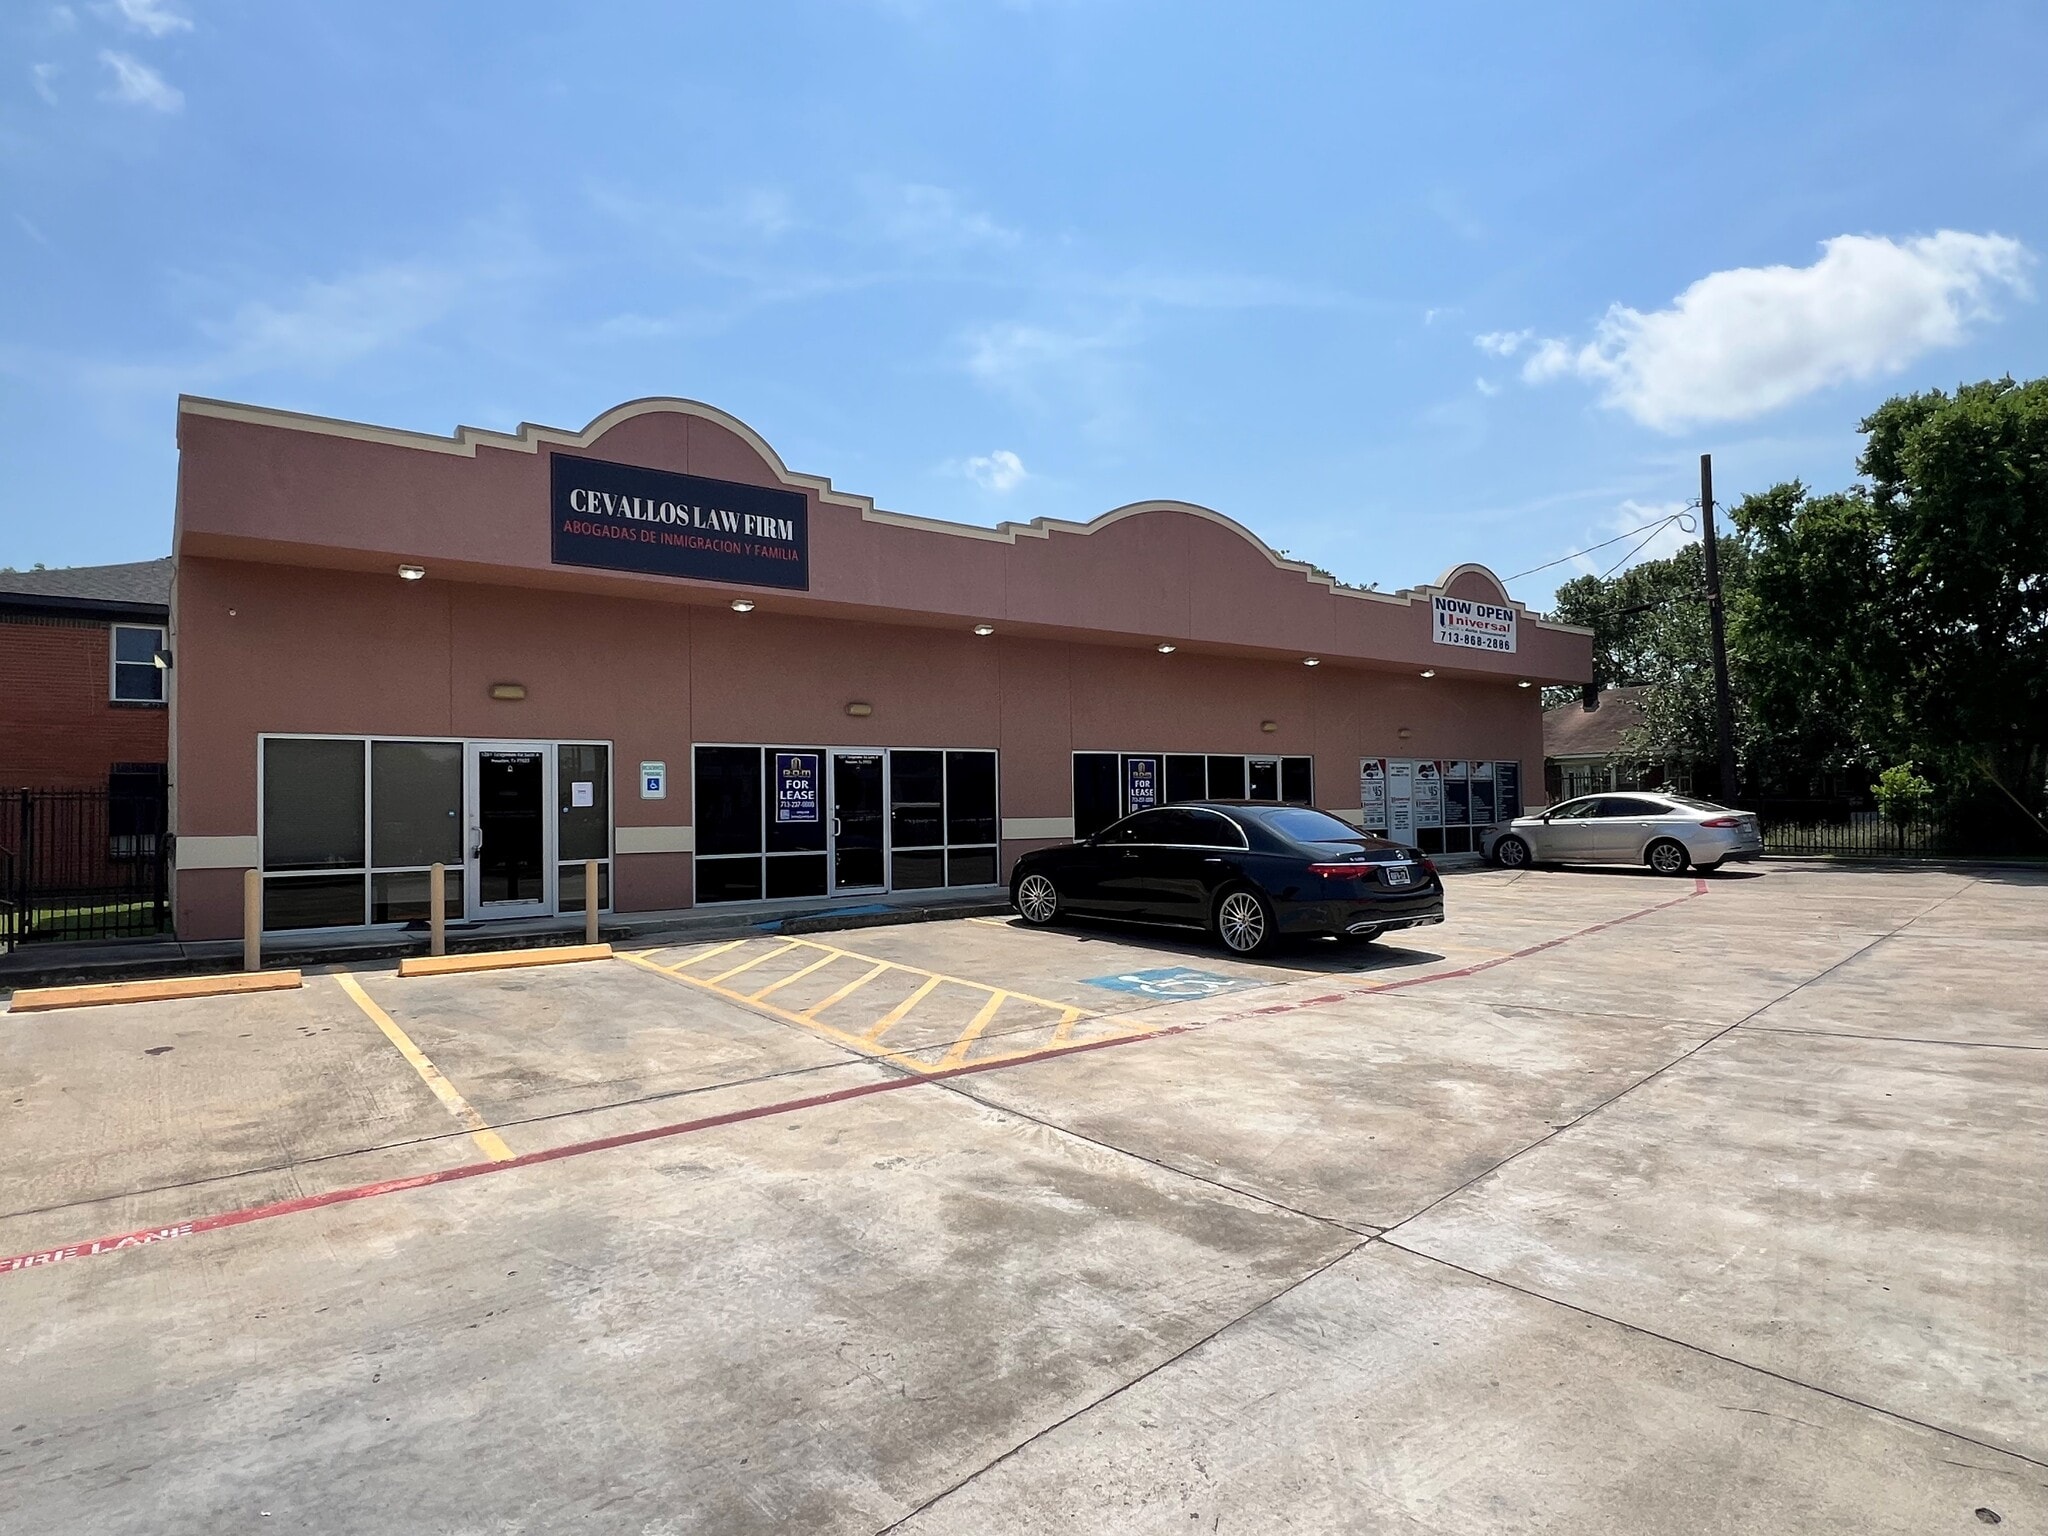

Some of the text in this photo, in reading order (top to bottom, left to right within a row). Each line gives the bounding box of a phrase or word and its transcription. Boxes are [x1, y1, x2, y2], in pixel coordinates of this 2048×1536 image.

[570, 488, 793, 541] CEVALLOS LAW FIRM
[563, 520, 799, 561] ABOGADAS DE INMIGRACION Y FAMILIA
[1435, 597, 1513, 621] NOW OPEN
[786, 780, 809, 789] FOR
[1131, 788, 1154, 796] LEASE
[1135, 780, 1150, 788] FOR
[780, 790, 815, 800] LEASE
[91, 1224, 193, 1255] LANE
